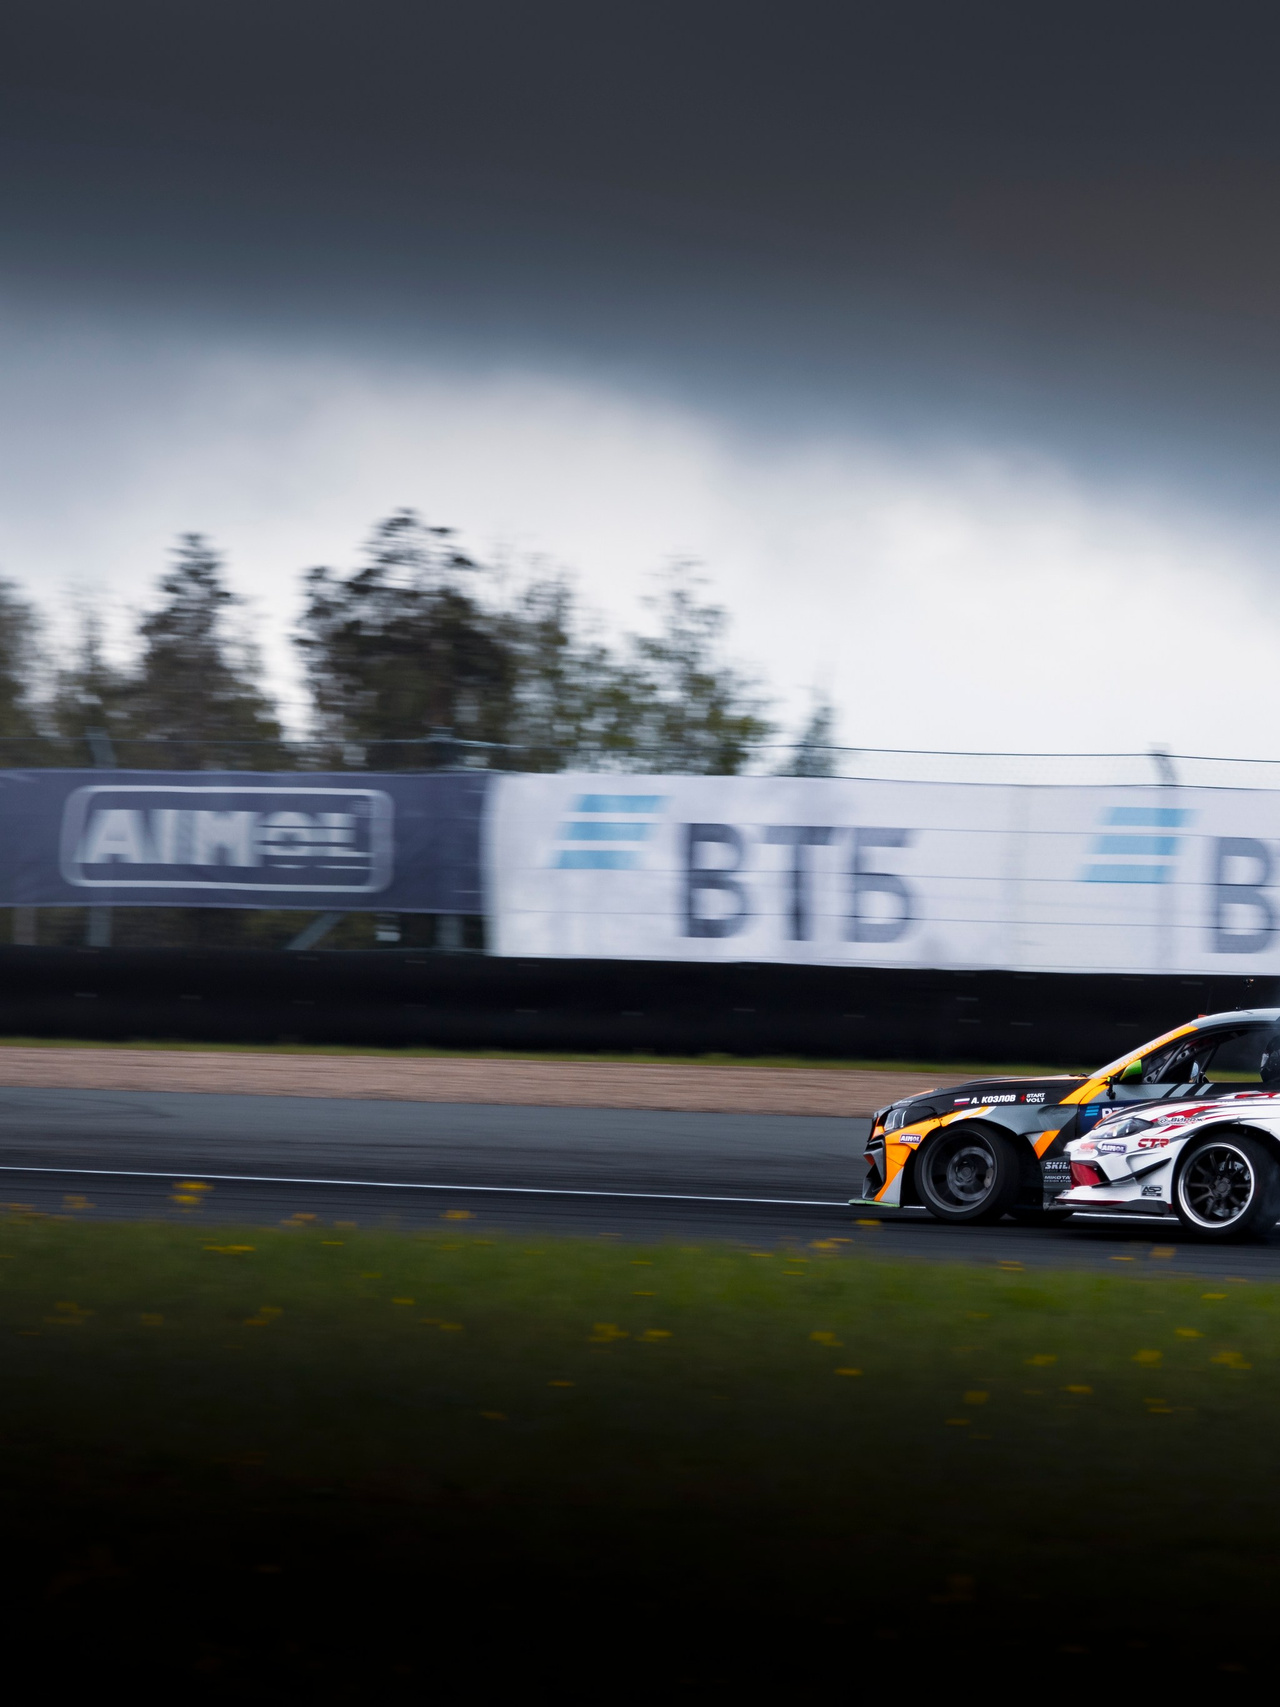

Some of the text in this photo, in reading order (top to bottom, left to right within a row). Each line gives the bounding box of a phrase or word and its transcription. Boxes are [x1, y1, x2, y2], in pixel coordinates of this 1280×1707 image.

[76, 808, 374, 869] AIMOL
[676, 823, 920, 945] ВТБ
[981, 1094, 1016, 1104] КОЗЛОВ
[1101, 1144, 1125, 1152] AIMOL
[1138, 1138, 1170, 1148] CTR
